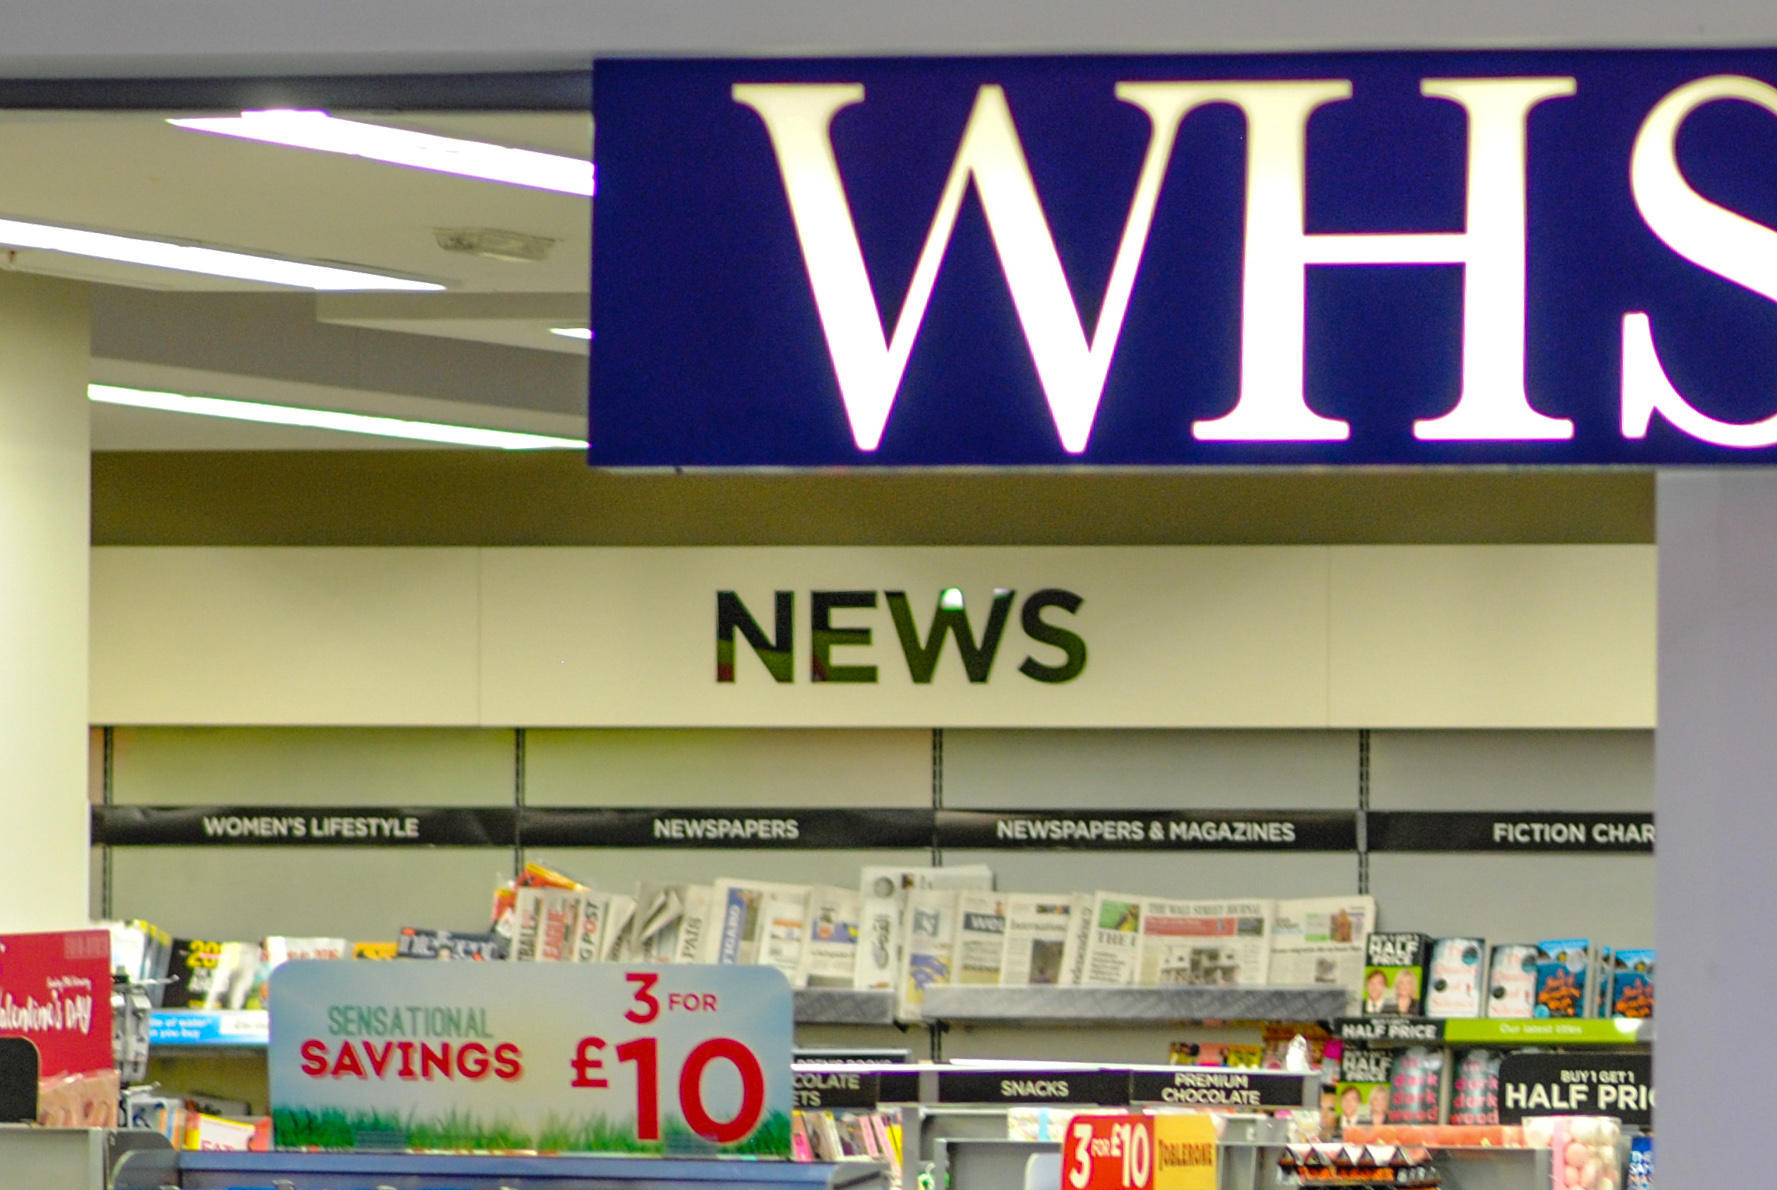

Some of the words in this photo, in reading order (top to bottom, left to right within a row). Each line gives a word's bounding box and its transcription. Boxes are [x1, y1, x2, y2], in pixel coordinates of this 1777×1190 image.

[715, 588, 1088, 685] NEWS
[203, 817, 307, 839] WOMEN'S
[311, 817, 420, 839] LIFESTYLE
[653, 819, 800, 840] NEWSPAPERS
[996, 820, 1144, 843] NEWSPAPERS
[1149, 821, 1165, 842] &
[1170, 821, 1296, 843] MAGAZINES
[1493, 822, 1587, 844] FICTION
[581, 901, 600, 944] POST
[624, 972, 660, 1025] 3
[667, 992, 718, 1012] FOR
[328, 1004, 493, 1039] SENSATIONAL
[1341, 1024, 1386, 1040] HALF
[1388, 1024, 1437, 1040] PRICE
[793, 1073, 861, 1090] COLATE
[1174, 1072, 1249, 1089] PREMIUM
[1393, 1074, 1438, 1088] dark
[1560, 1069, 1590, 1083] BUY
[1600, 1070, 1626, 1083] GET
[299, 1040, 525, 1083] SAVINGS
[570, 1036, 765, 1144] £10
[1000, 1079, 1069, 1098] SNACKS
[1161, 1087, 1261, 1106] CHOCOLATE
[1392, 1090, 1438, 1106] dark
[1504, 1082, 1588, 1110] HALF
[1069, 1122, 1093, 1190] 3
[1090, 1138, 1111, 1158] FOR
[1111, 1122, 1151, 1190] £10
[1158, 1138, 1213, 1172] TOBLERONE
